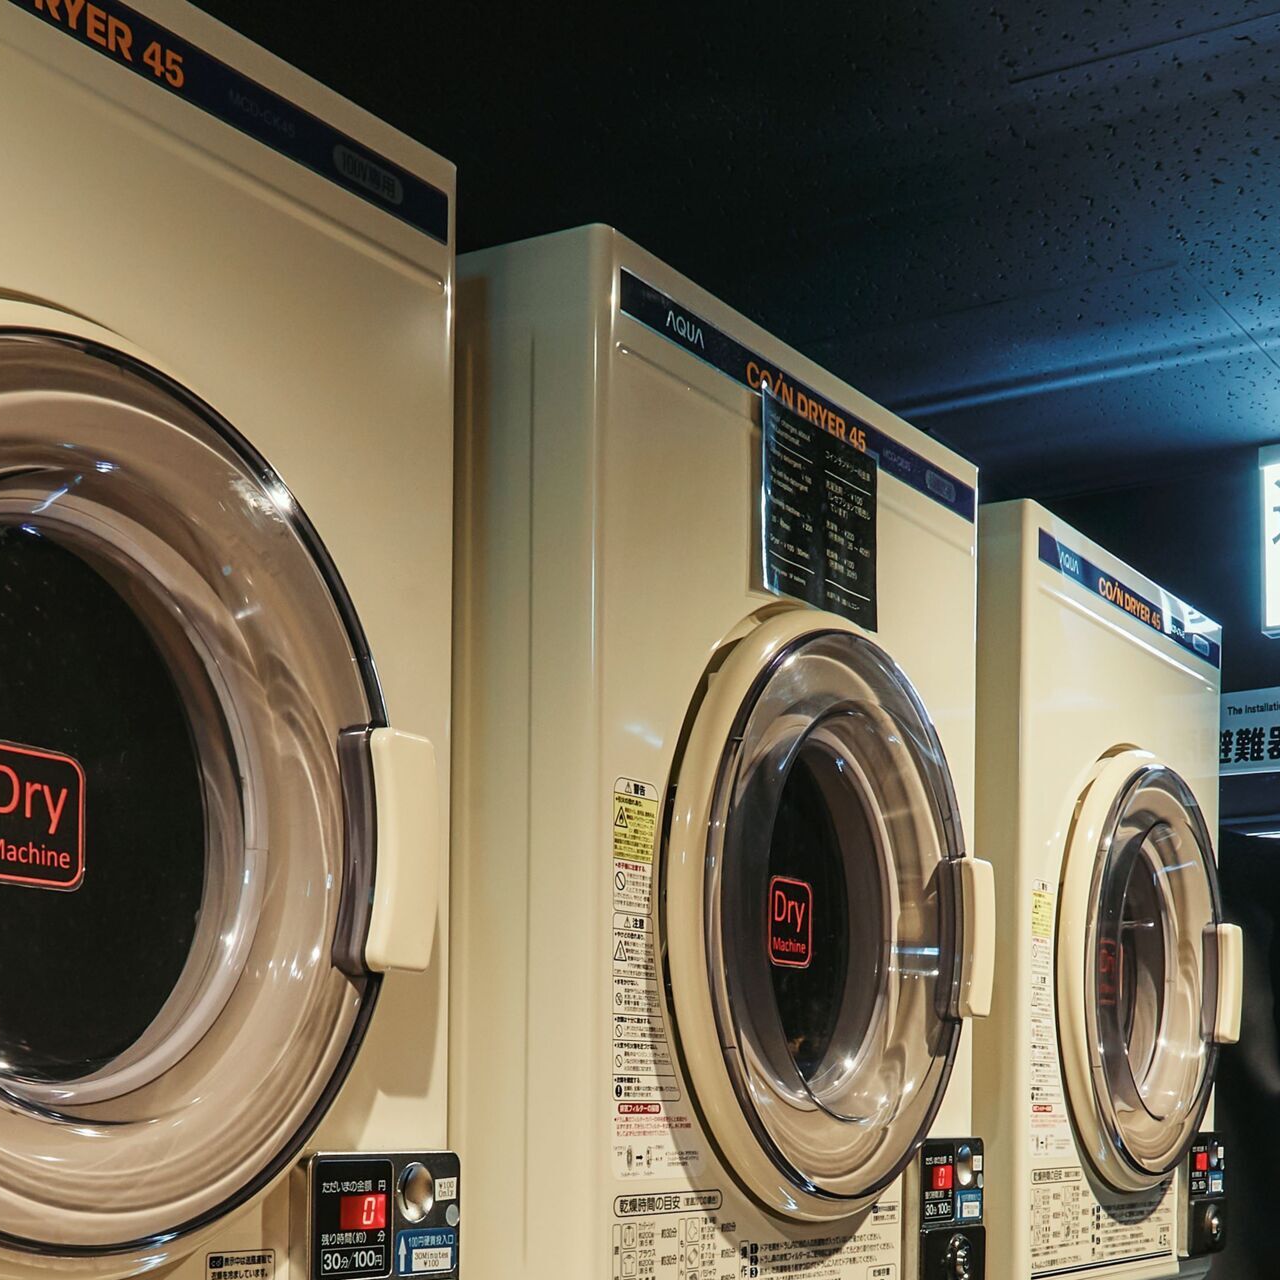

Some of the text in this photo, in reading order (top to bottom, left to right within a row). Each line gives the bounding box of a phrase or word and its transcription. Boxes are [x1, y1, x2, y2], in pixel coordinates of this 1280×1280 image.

[143, 40, 185, 88] 45
[667, 310, 704, 349] AQUA
[797, 394, 845, 441] DRYER
[850, 426, 866, 453] 45
[1125, 594, 1150, 623] DRYER
[1152, 612, 1160, 630] 45
[1228, 706, 1243, 716] The
[775, 890, 805, 932] Dry
[632, 917, 644, 930] 注意
[773, 936, 806, 954] Machine
[322, 1180, 386, 1193] ただいまの金額 円
[438, 1188, 454, 1198] Only
[363, 1197, 375, 1225] 0
[377, 1231, 385, 1241] 分
